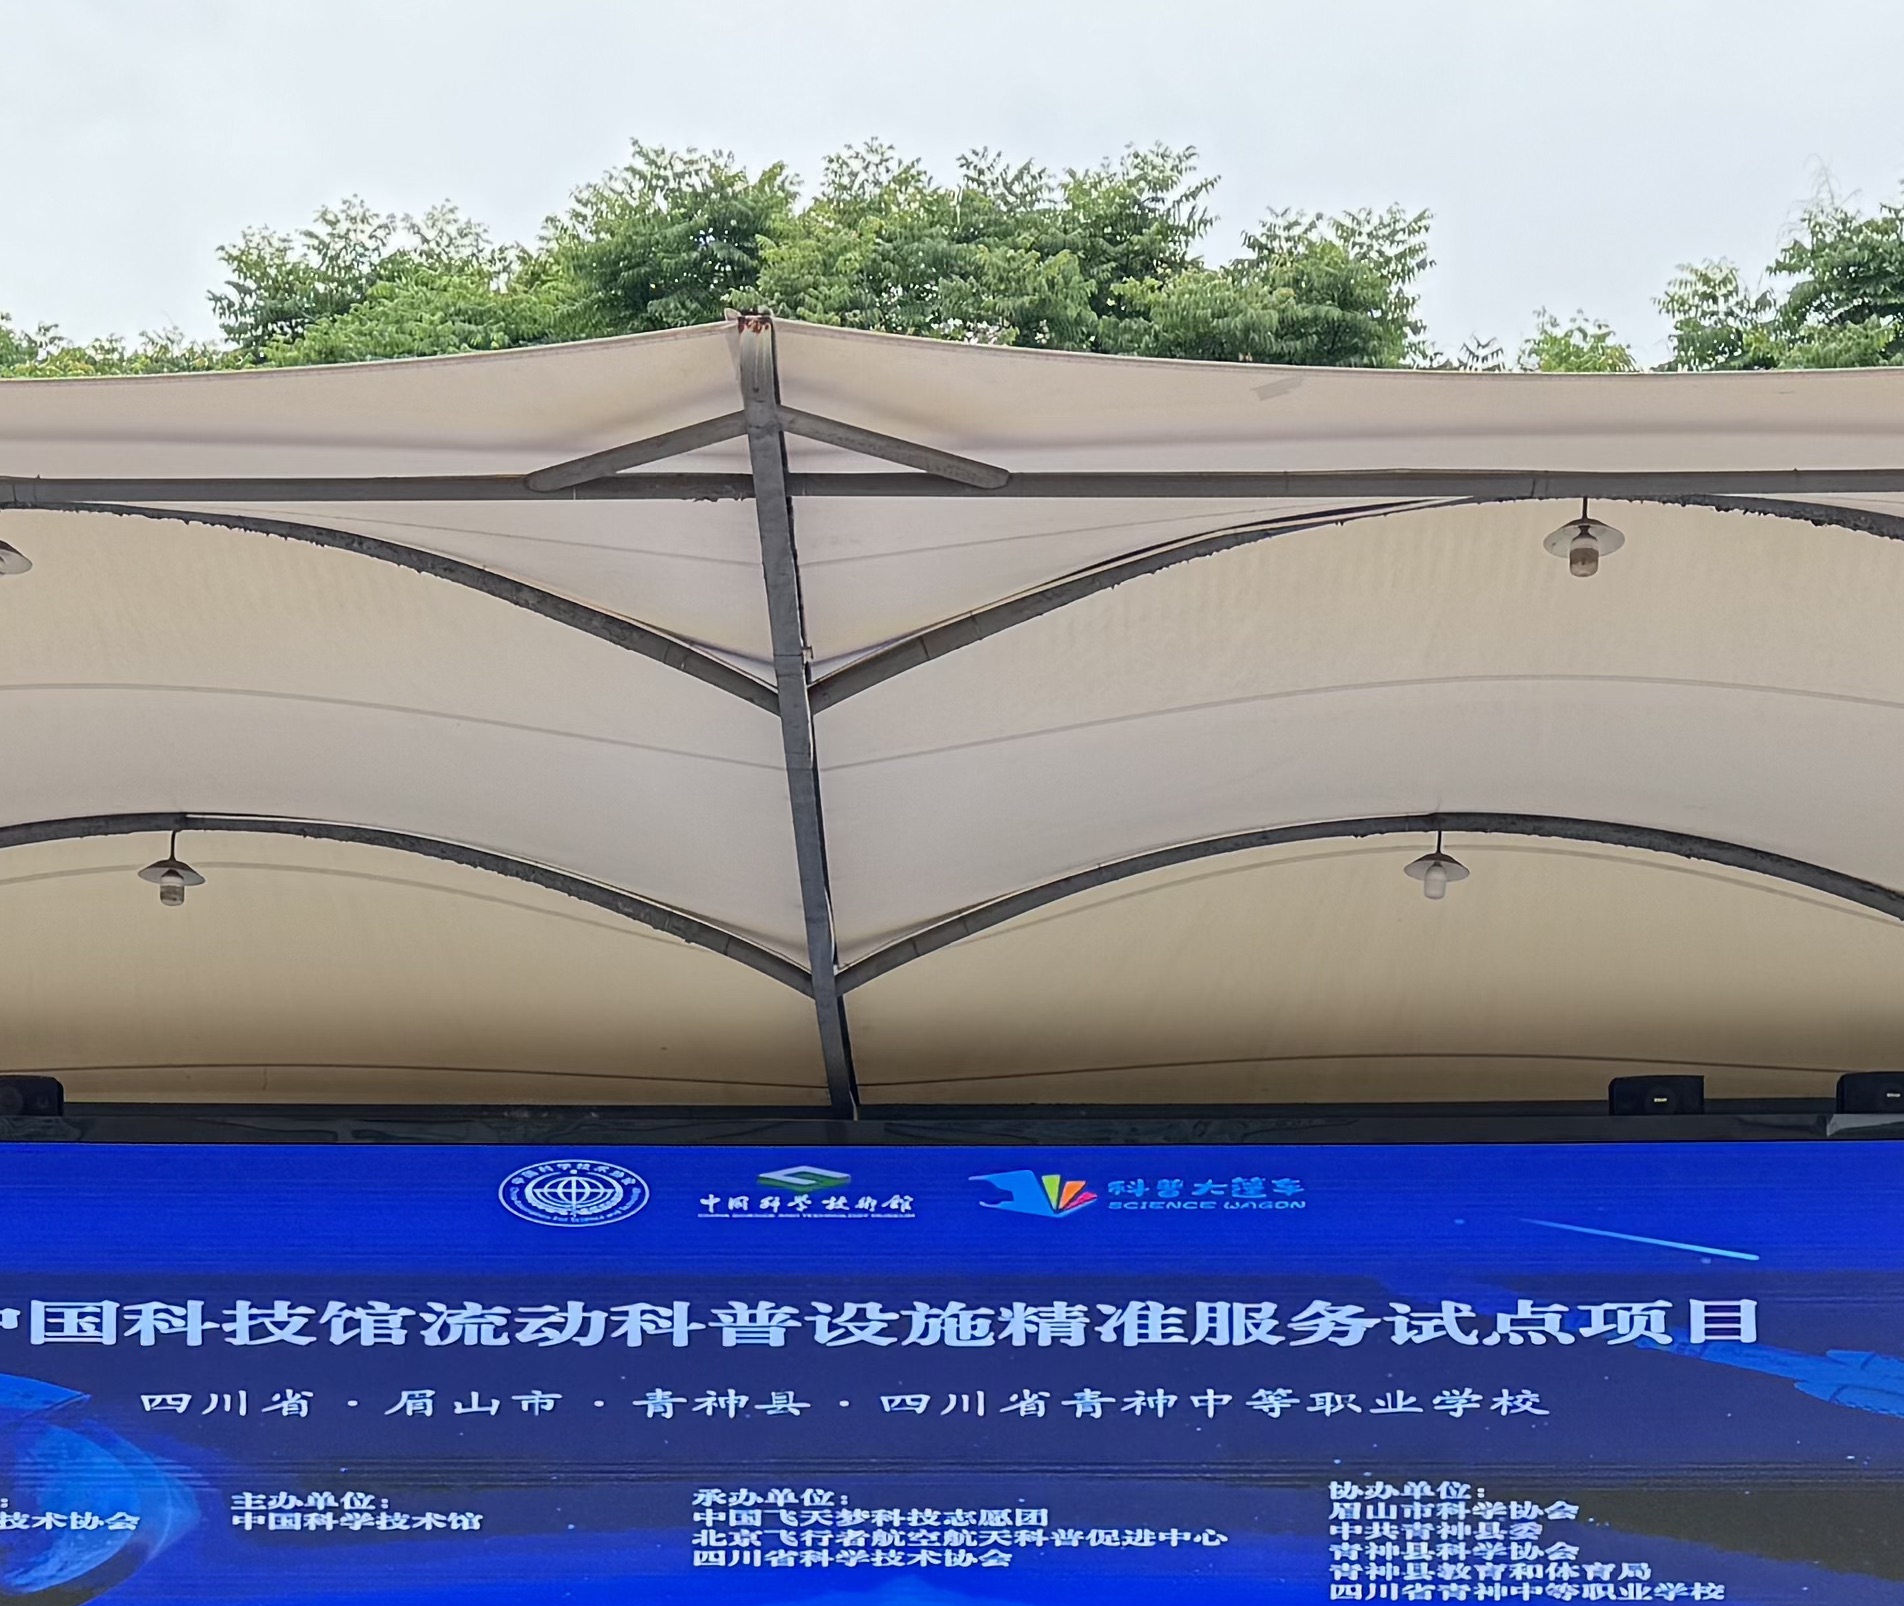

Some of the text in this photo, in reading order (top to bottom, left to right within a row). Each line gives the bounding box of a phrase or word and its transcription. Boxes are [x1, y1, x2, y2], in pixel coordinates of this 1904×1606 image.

[1107, 1177, 1304, 1199] 科普大篷车
[1108, 1200, 1306, 1210] SCIENCE WAGON
[693, 1509, 1048, 1527] 中国飞天梦科技志愿团
[1329, 1501, 1580, 1520] 眉山市科学协会
[232, 1512, 483, 1531] 中国科学技术馆
[692, 1529, 1228, 1547] 北京飞行者航空航天科普促进中心
[1329, 1522, 1543, 1541] 中共青神县委
[693, 1549, 1013, 1567] 四川省科学技术协会
[1329, 1542, 1580, 1561] 青神县科学协会
[1329, 1562, 1652, 1581] 青神县教育和体育局
[1329, 1582, 1725, 1601] 四川省青神中等职业学校
